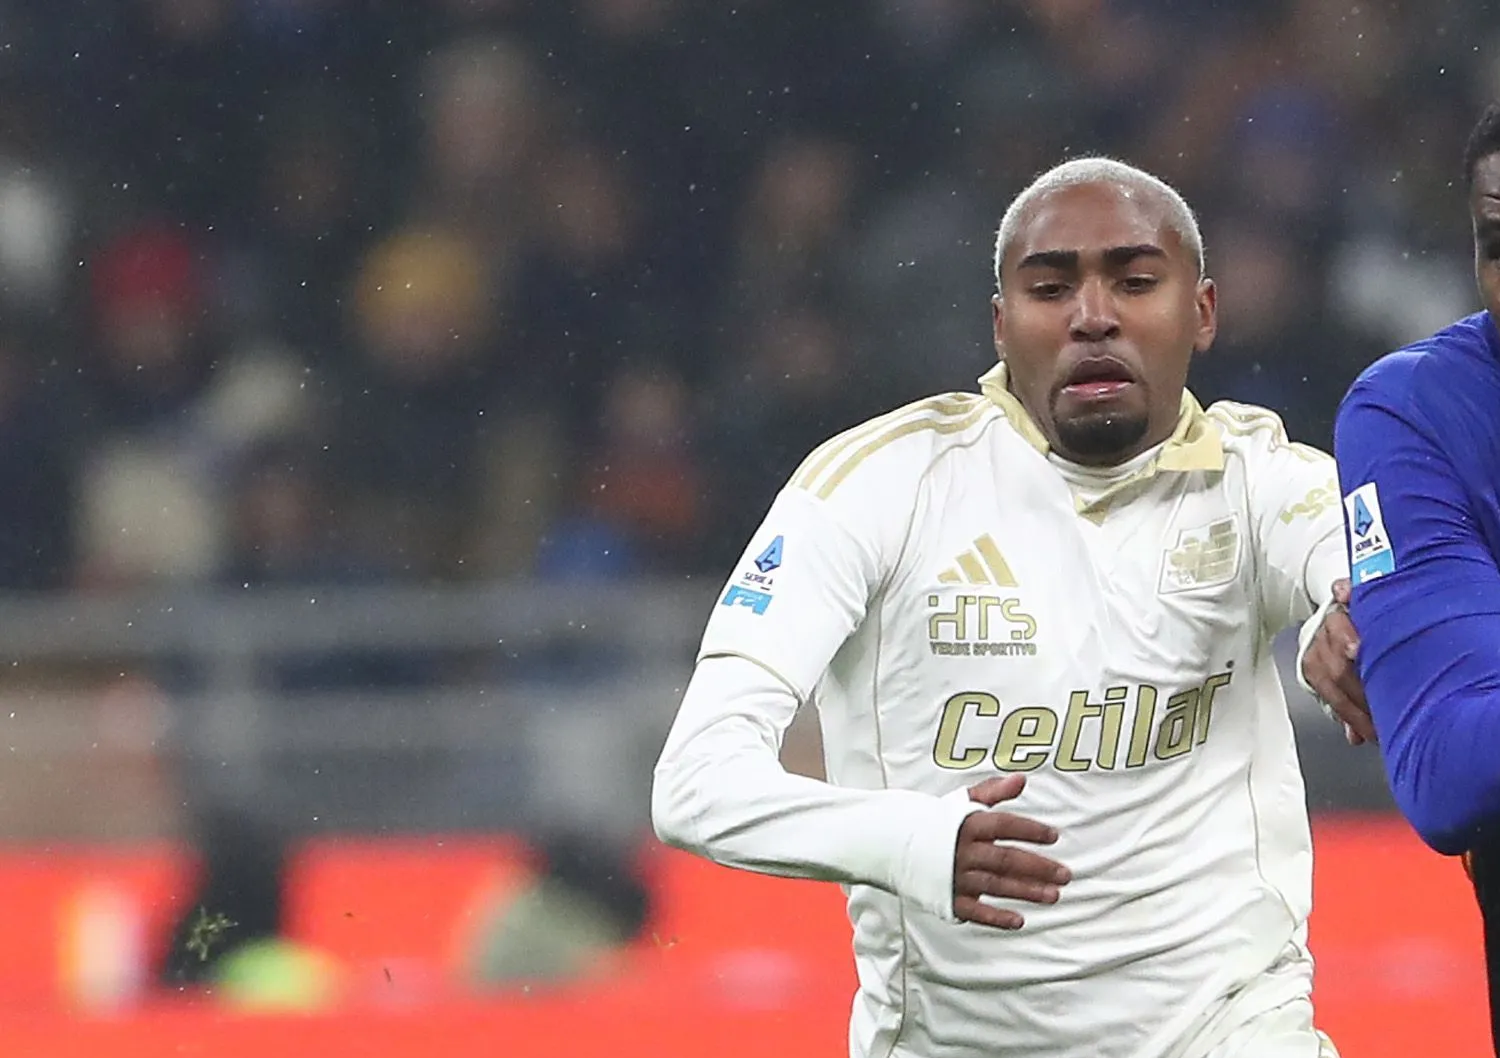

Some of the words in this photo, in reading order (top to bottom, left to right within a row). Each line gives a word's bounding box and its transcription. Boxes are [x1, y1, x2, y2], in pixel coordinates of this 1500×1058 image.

[928, 594, 1037, 640] HTS
[929, 641, 971, 656] VERDE
[932, 671, 1233, 772] Cetilar
